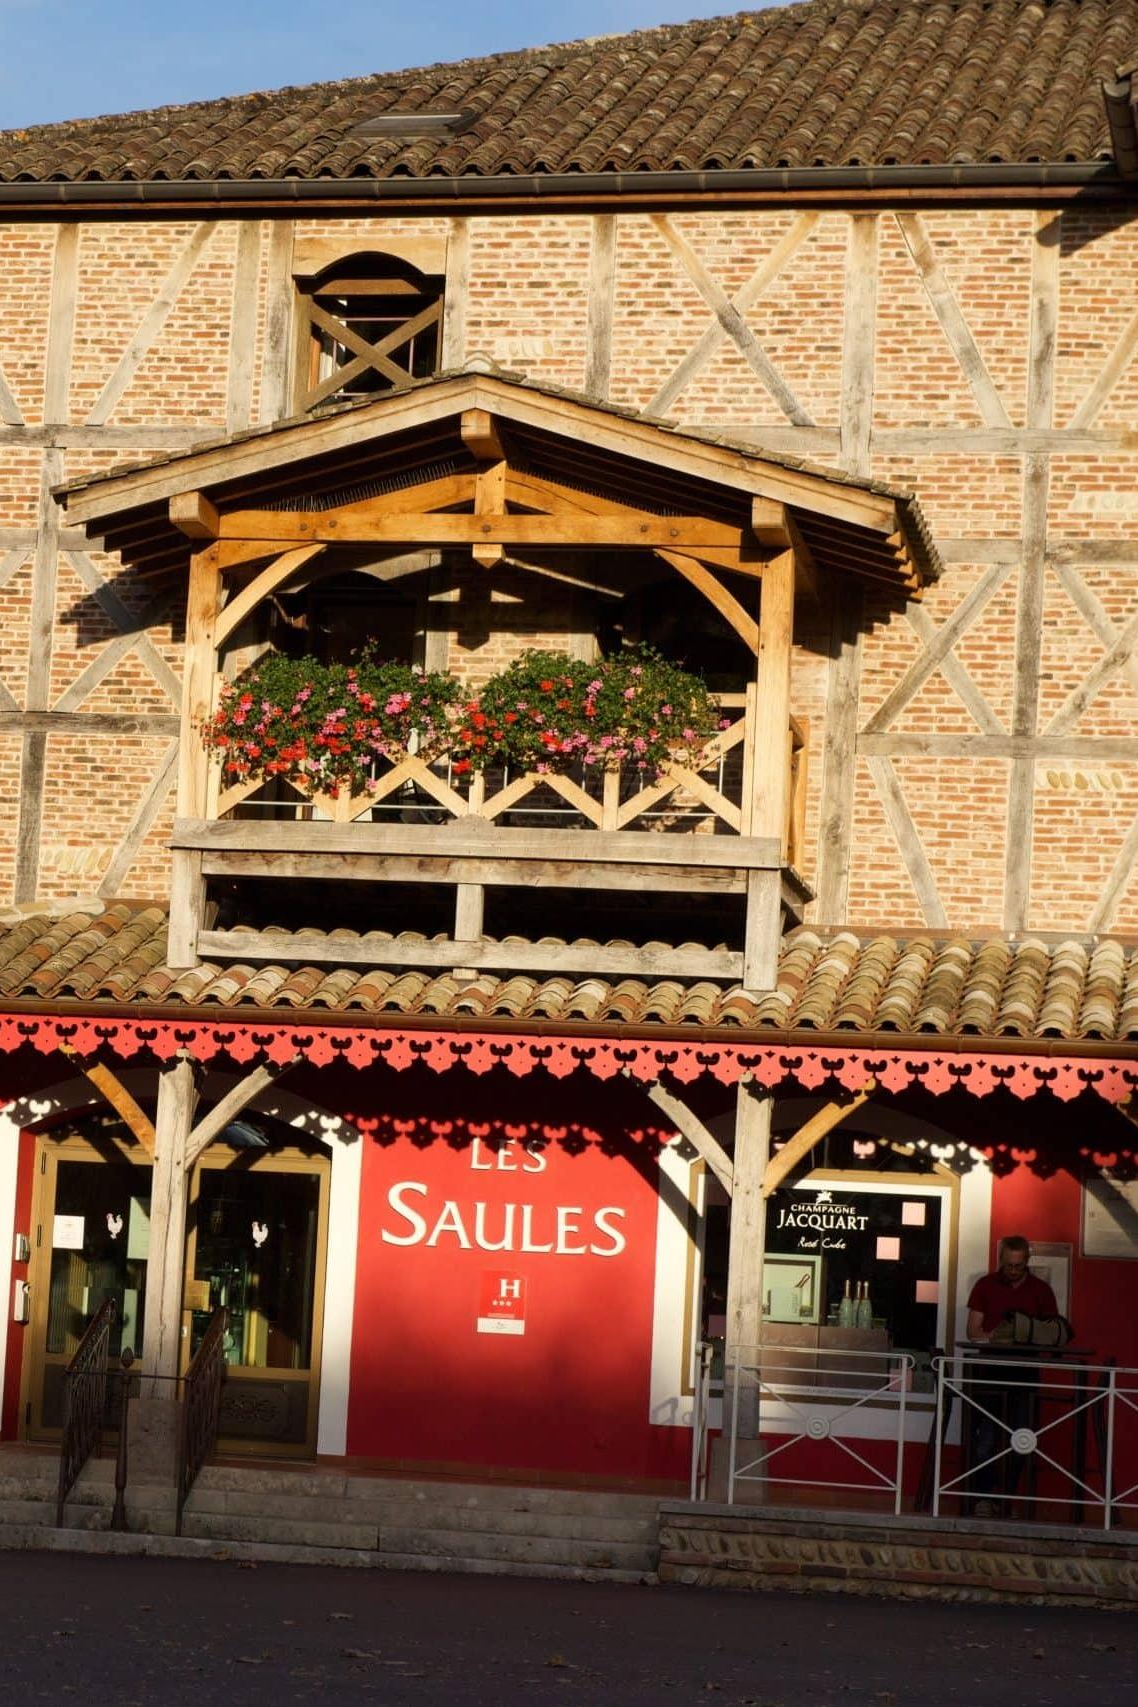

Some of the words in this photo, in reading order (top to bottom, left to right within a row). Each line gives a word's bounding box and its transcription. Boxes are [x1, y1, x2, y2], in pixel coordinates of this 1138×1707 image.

[470, 1138, 547, 1173] LES
[381, 1181, 627, 1257] SAULES
[776, 1209, 869, 1232] JACQUART
[790, 1203, 856, 1215] CHAMPAGNE
[500, 1278, 521, 1298] H
